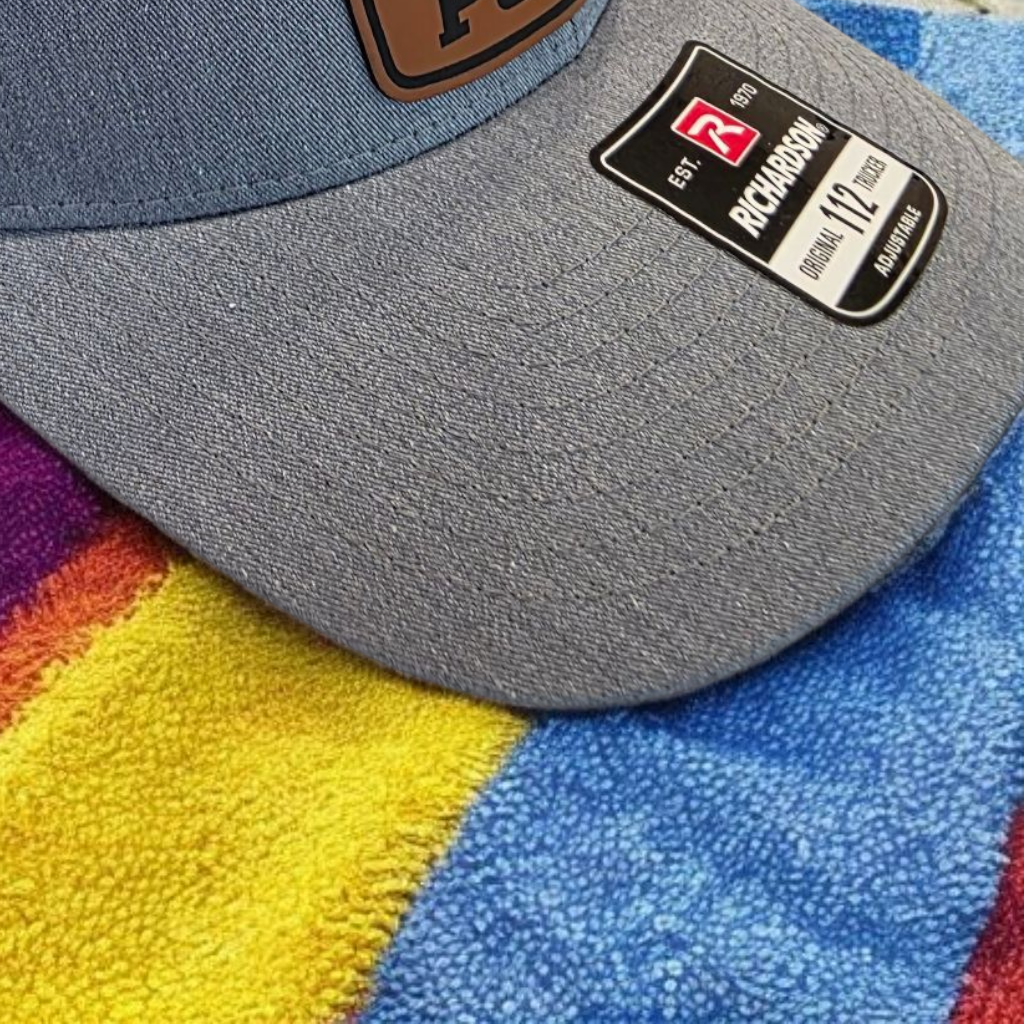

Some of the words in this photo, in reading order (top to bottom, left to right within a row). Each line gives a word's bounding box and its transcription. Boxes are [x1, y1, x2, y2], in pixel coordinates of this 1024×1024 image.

[667, 156, 702, 190] EST.
[730, 82, 758, 109] 1970
[852, 155, 888, 192] TRUCKER
[819, 182, 880, 235] 112
[799, 227, 845, 280] ORIGINAL
[873, 204, 922, 277] ADJUSTABLE
